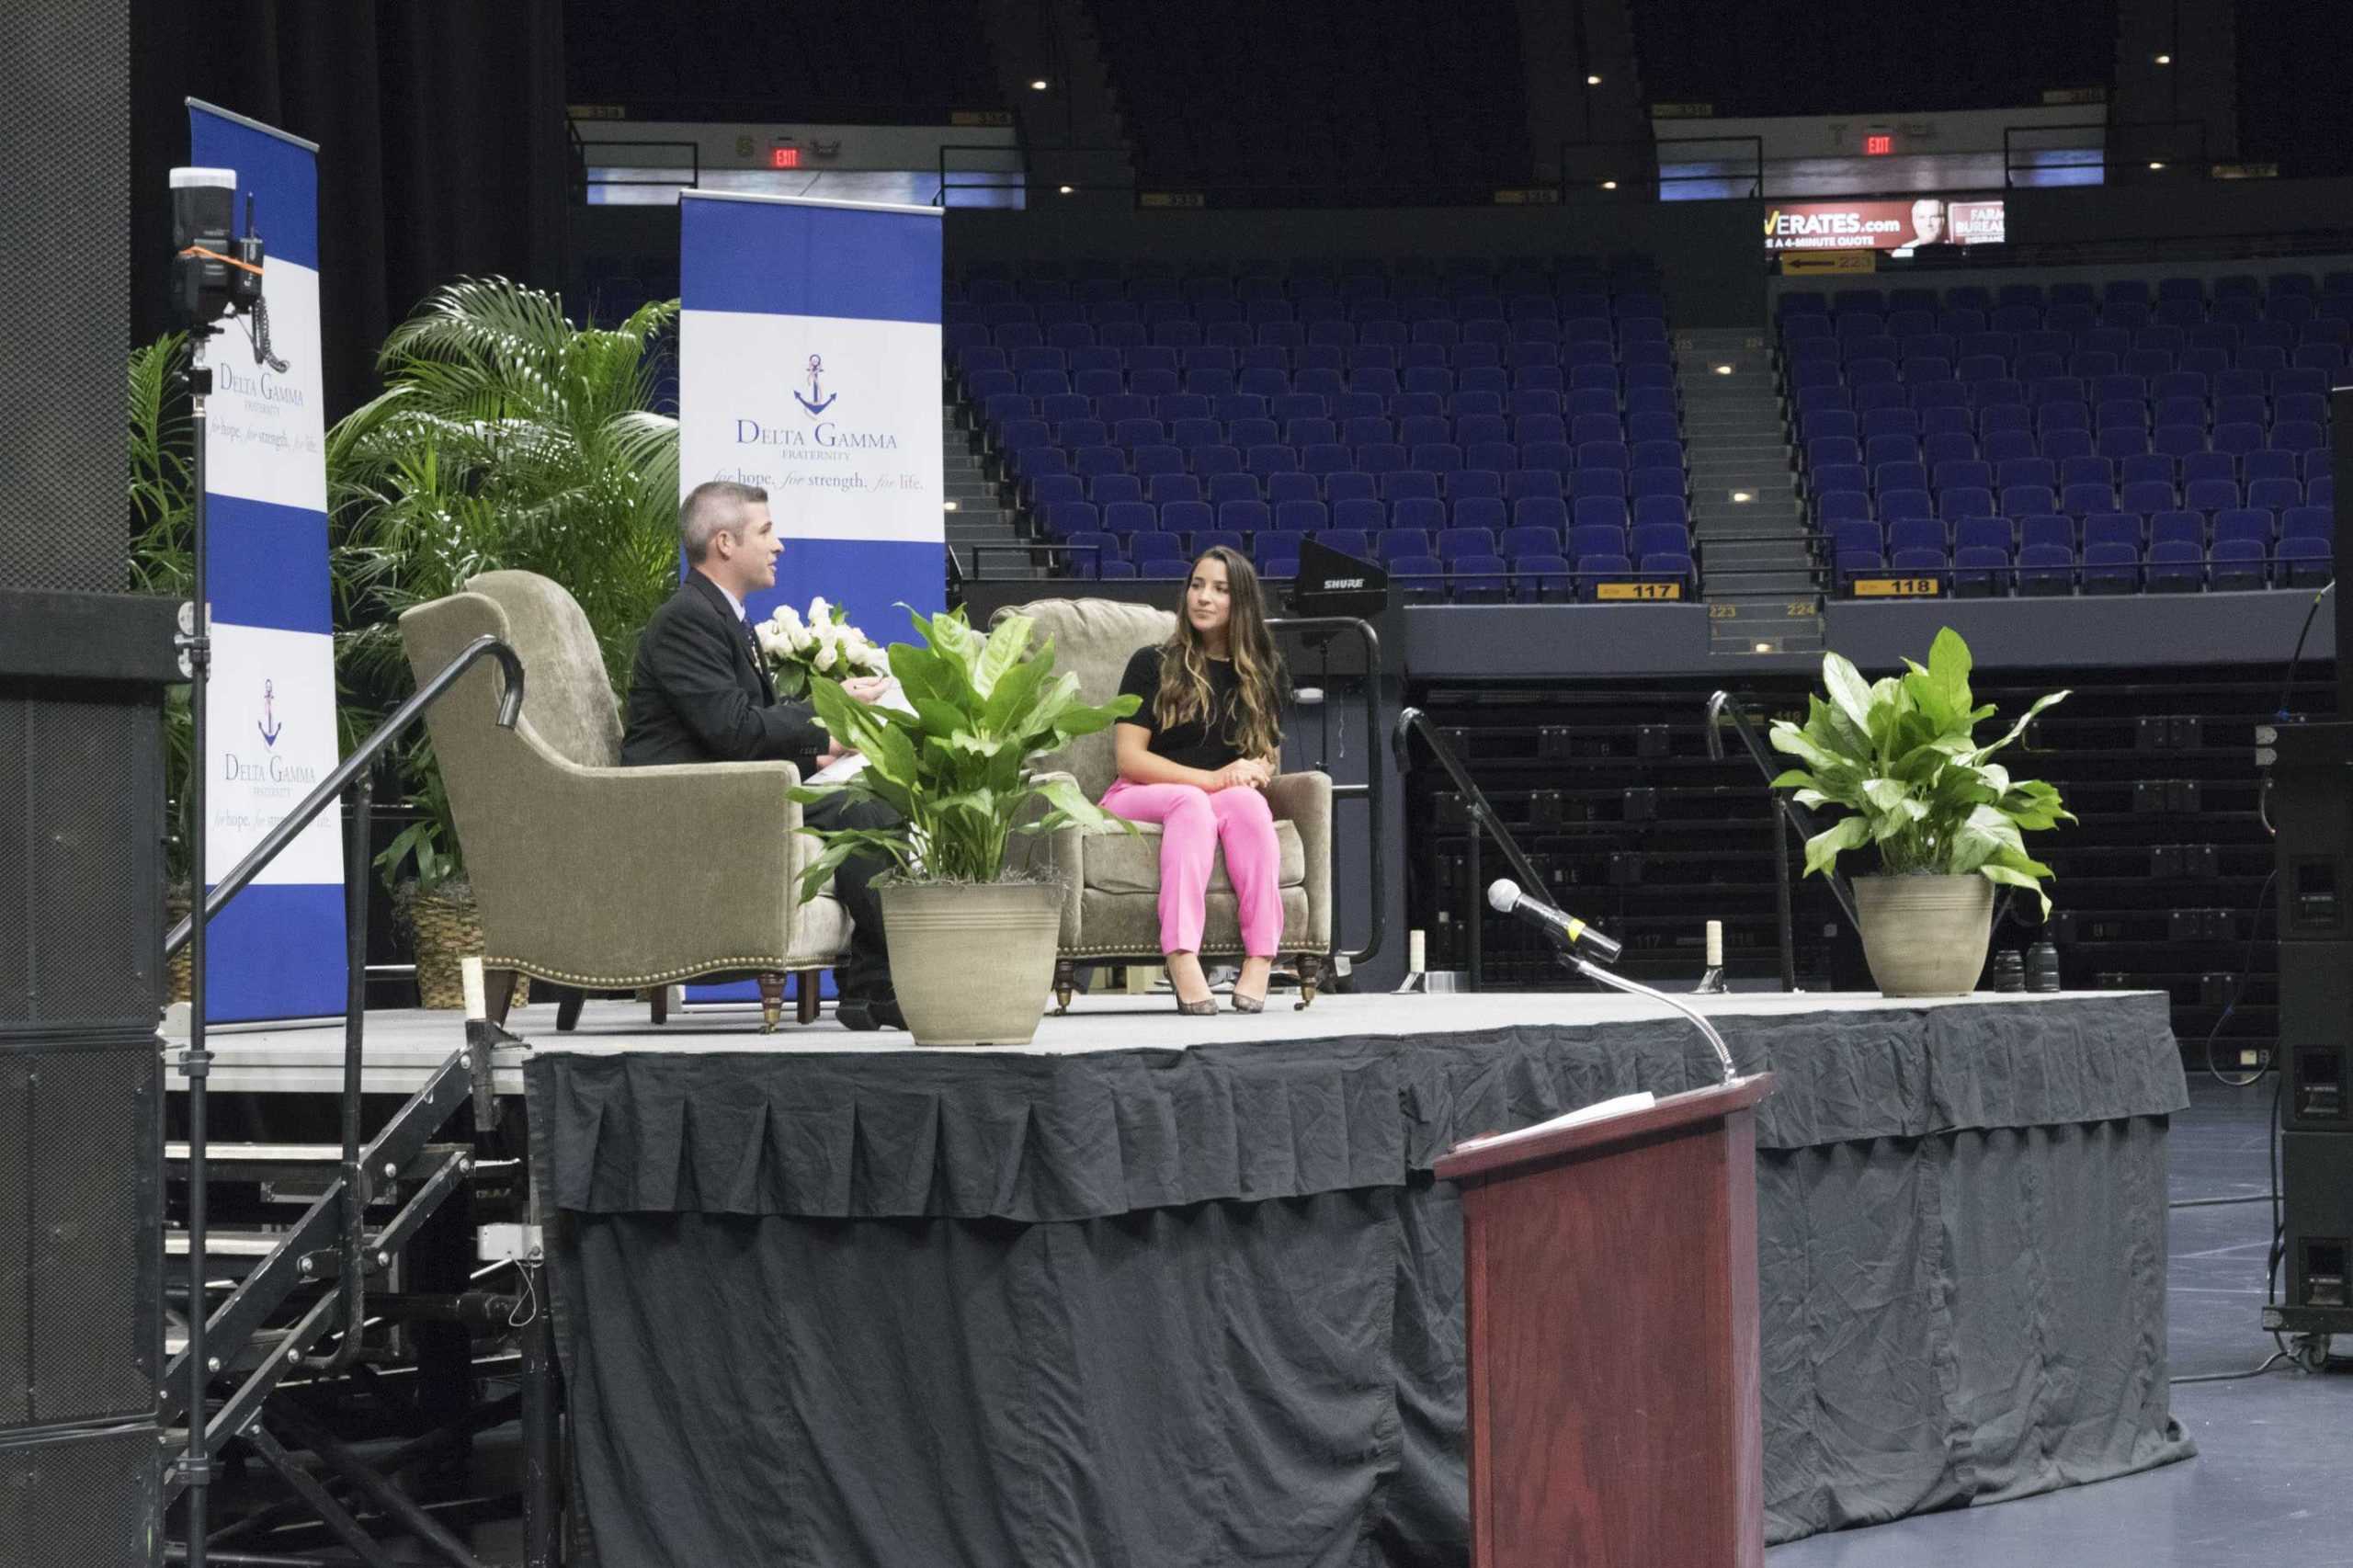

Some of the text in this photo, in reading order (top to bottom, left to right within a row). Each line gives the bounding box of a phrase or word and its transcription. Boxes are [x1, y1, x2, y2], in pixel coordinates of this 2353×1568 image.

[1868, 137, 1890, 154] EXIT
[775, 149, 797, 167] EXIT
[1775, 237, 1784, 247] A
[1785, 236, 1836, 247] 4-MINUTE
[1836, 235, 1875, 246] QUOTE
[781, 449, 852, 461] FRATERNITY
[737, 468, 776, 487] hope.
[780, 472, 805, 492] for
[808, 472, 869, 492] strength.
[873, 475, 897, 494] for
[900, 474, 925, 491] life.
[1324, 578, 1364, 588] SHURE
[1890, 581, 1929, 594] 118
[1633, 585, 1671, 597] 117
[1710, 606, 1735, 618] 223
[1787, 603, 1815, 616] 224
